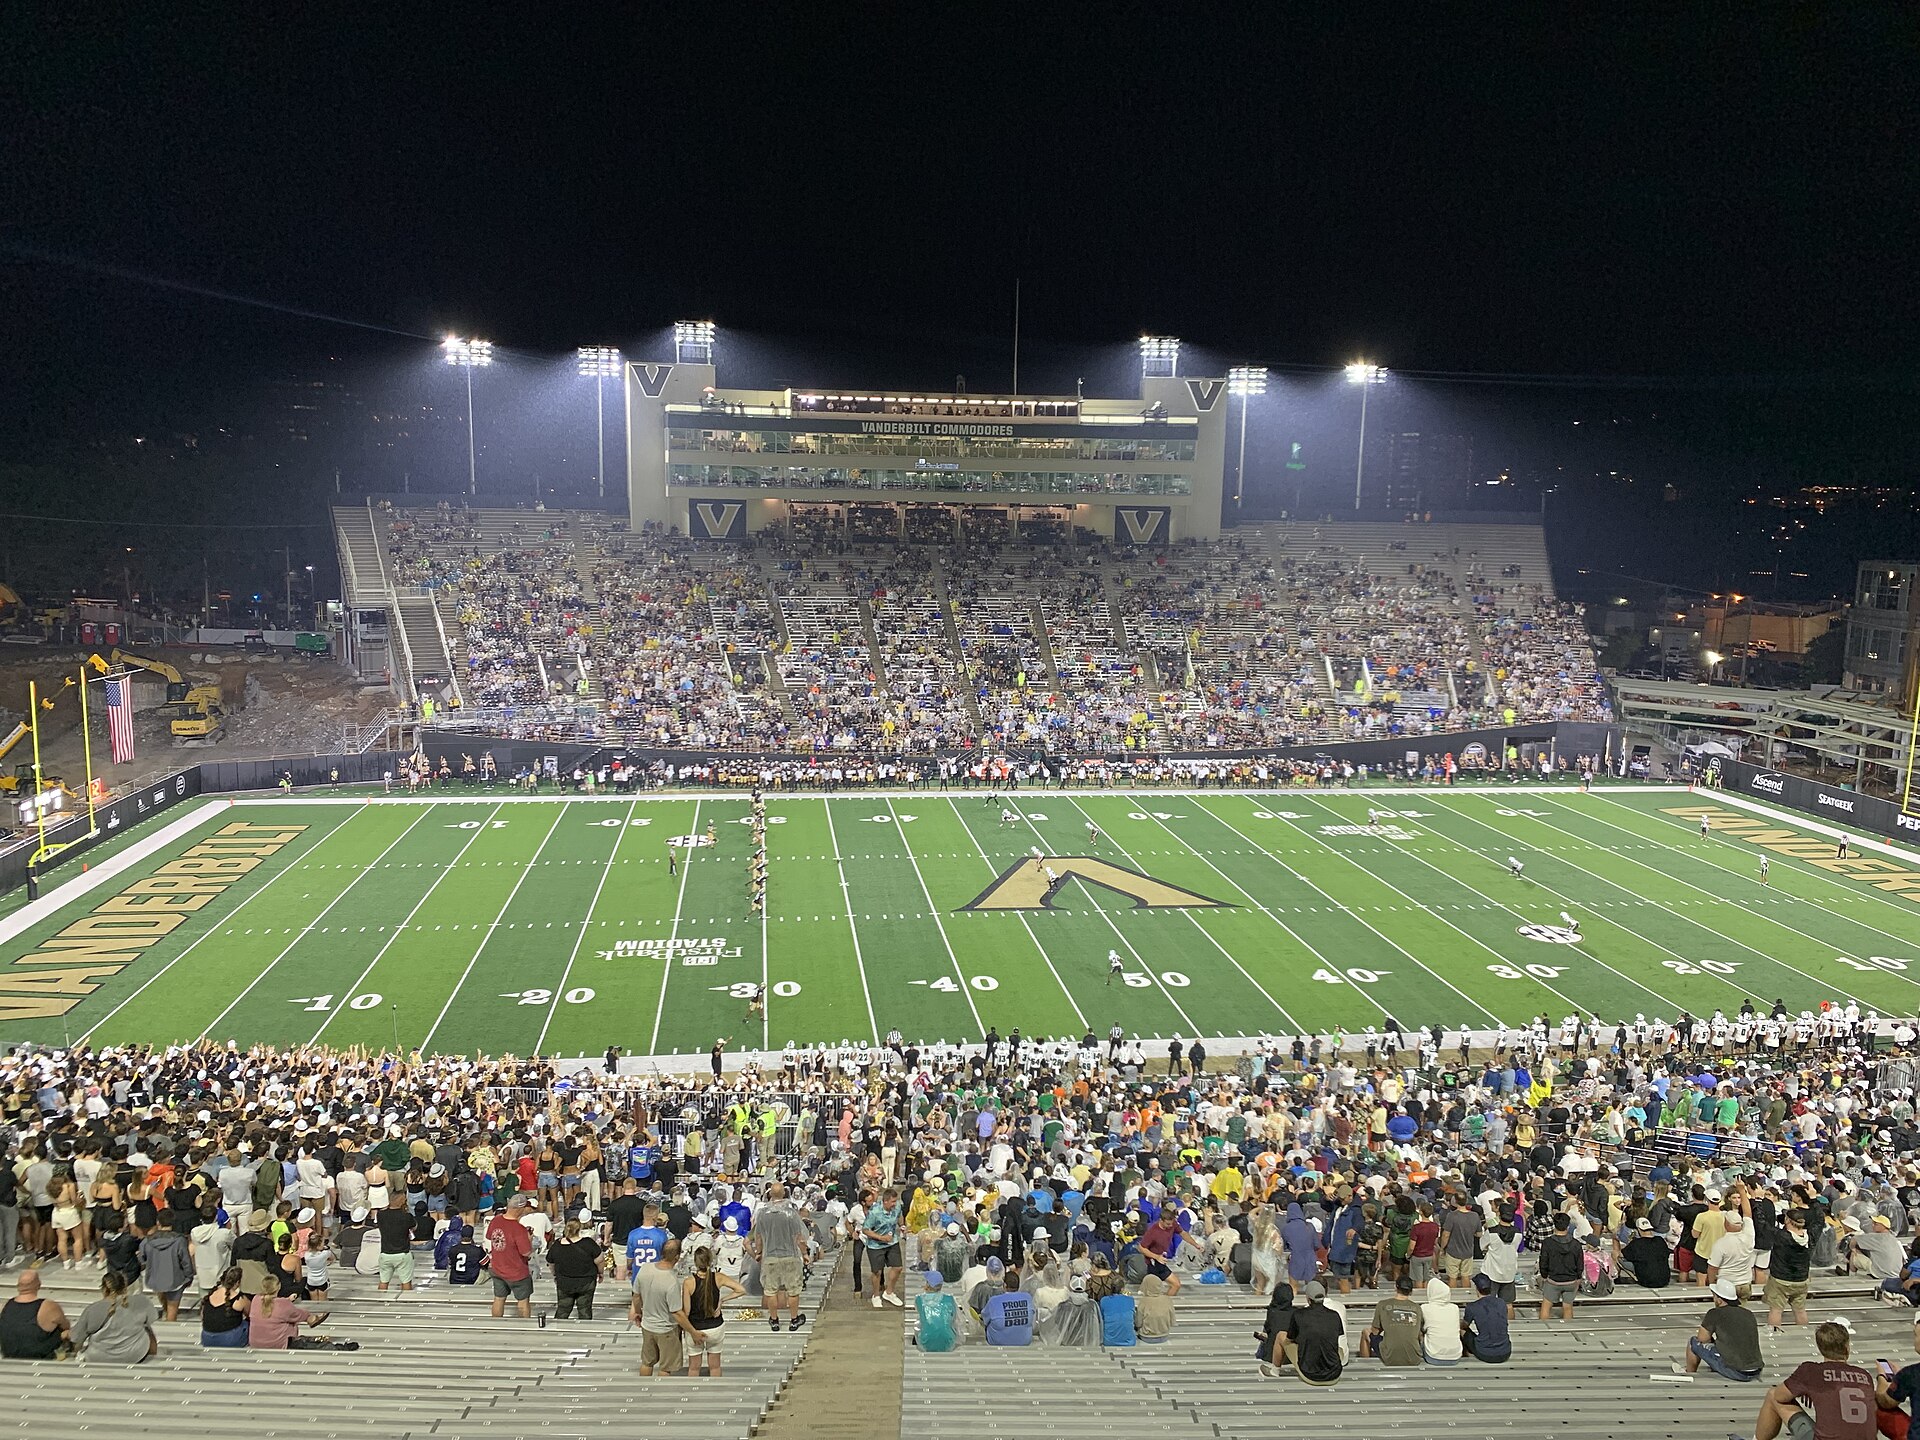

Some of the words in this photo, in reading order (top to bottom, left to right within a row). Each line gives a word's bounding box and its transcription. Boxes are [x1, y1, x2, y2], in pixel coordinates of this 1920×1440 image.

[630, 363, 674, 398] V
[1185, 380, 1226, 412] V
[862, 422, 931, 435] VANDERBILT
[933, 424, 1014, 436] COMMODORES
[696, 503, 743, 539] V
[1119, 510, 1165, 545] V
[1752, 773, 1784, 791] Ascend
[1818, 792, 1854, 813] SEATGEEK
[1656, 805, 1920, 904] VANDER
[0, 821, 311, 1021] VANDERBILT
[614, 937, 727, 950] STADIUM
[594, 946, 744, 961] FirstBank
[1486, 963, 1559, 979] 30
[1661, 959, 1736, 975] 20
[1835, 956, 1909, 971] 10
[929, 975, 999, 992] 40
[1122, 971, 1191, 988] 50
[1312, 968, 1379, 984] 40
[517, 987, 596, 1005] 20
[729, 980, 802, 998] 30
[304, 993, 383, 1011] 10
[455, 1252, 467, 1272] 2
[634, 1248, 657, 1267] 22
[1002, 1299, 1028, 1310] PROUD
[1823, 1369, 1871, 1386] SLATER
[1839, 1387, 1868, 1424] 6
